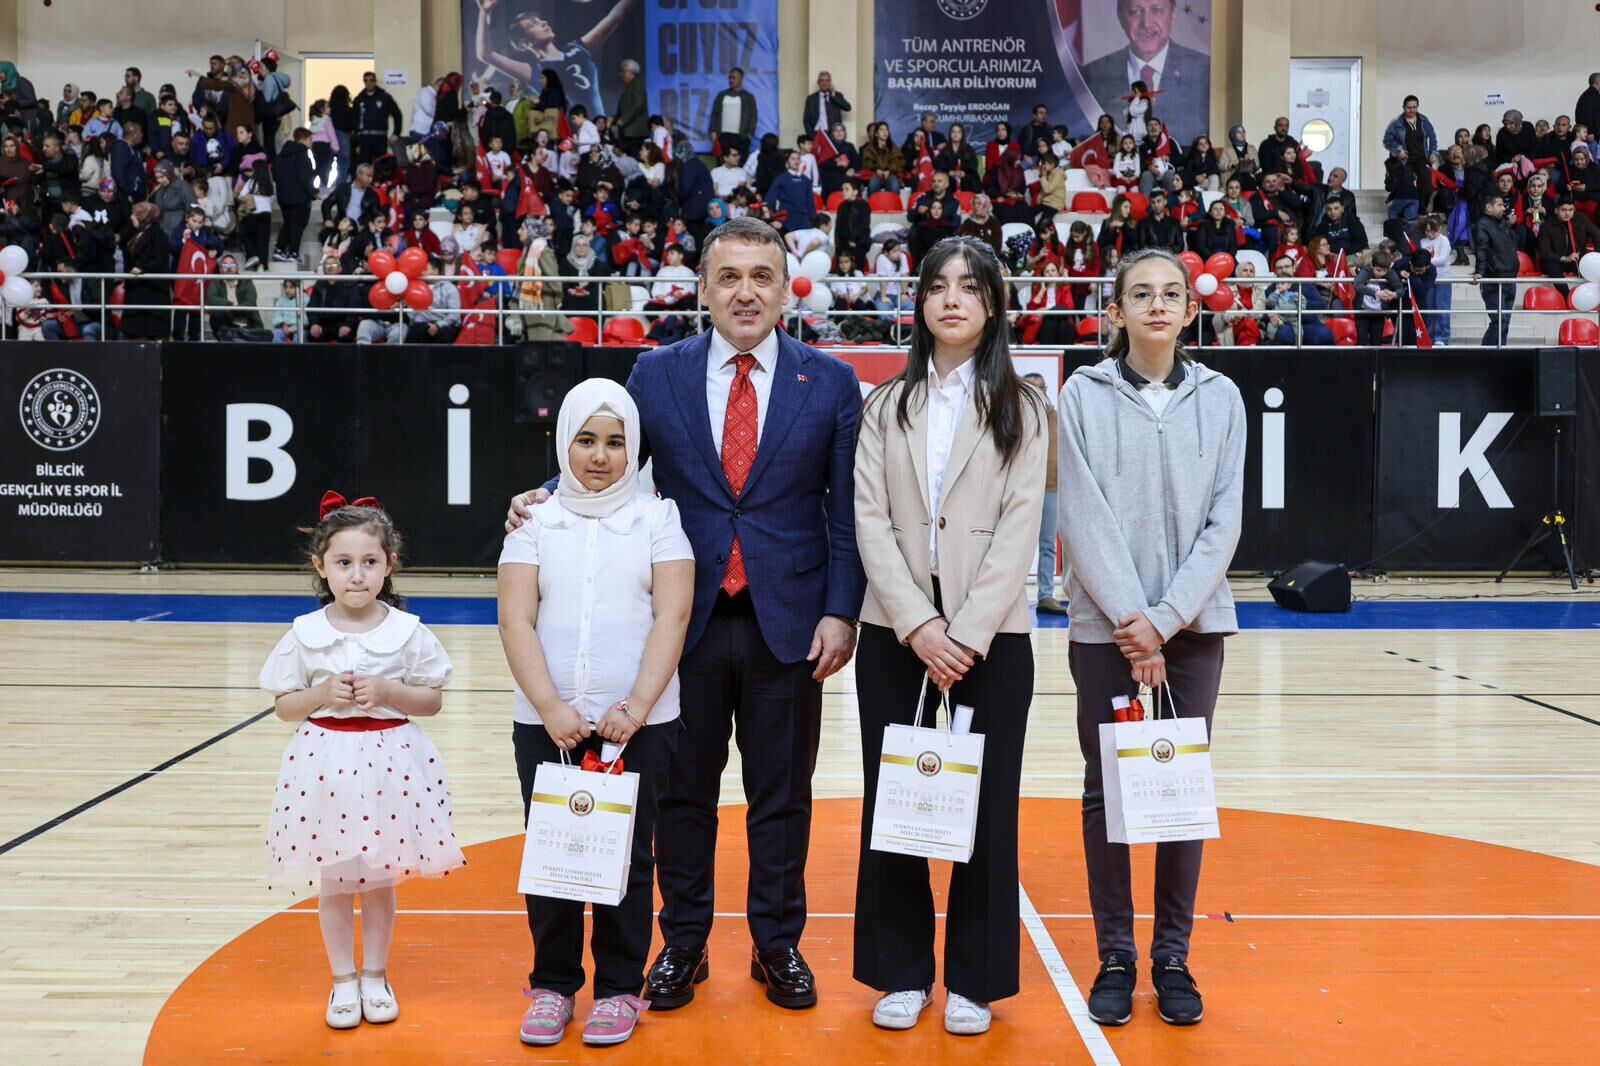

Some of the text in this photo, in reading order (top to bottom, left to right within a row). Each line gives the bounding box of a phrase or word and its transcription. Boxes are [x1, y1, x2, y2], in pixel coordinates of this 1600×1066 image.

[902, 36, 1025, 53] TÜM ANTRENÖR
[885, 59, 1043, 73] VE SPORCULARIMIZA
[888, 75, 1037, 92] BAŞARILAR DİLİYORUM
[913, 102, 1010, 112] Recep Tayyip ERDOĞAN
[938, 113, 1009, 123] UMHURBAŞKANI
[36, 462, 85, 477] BİLECİK
[0, 482, 123, 499] GENÇLİK VE SPOR İL
[18, 501, 103, 517] MÜDÜRLÜĞÜ
